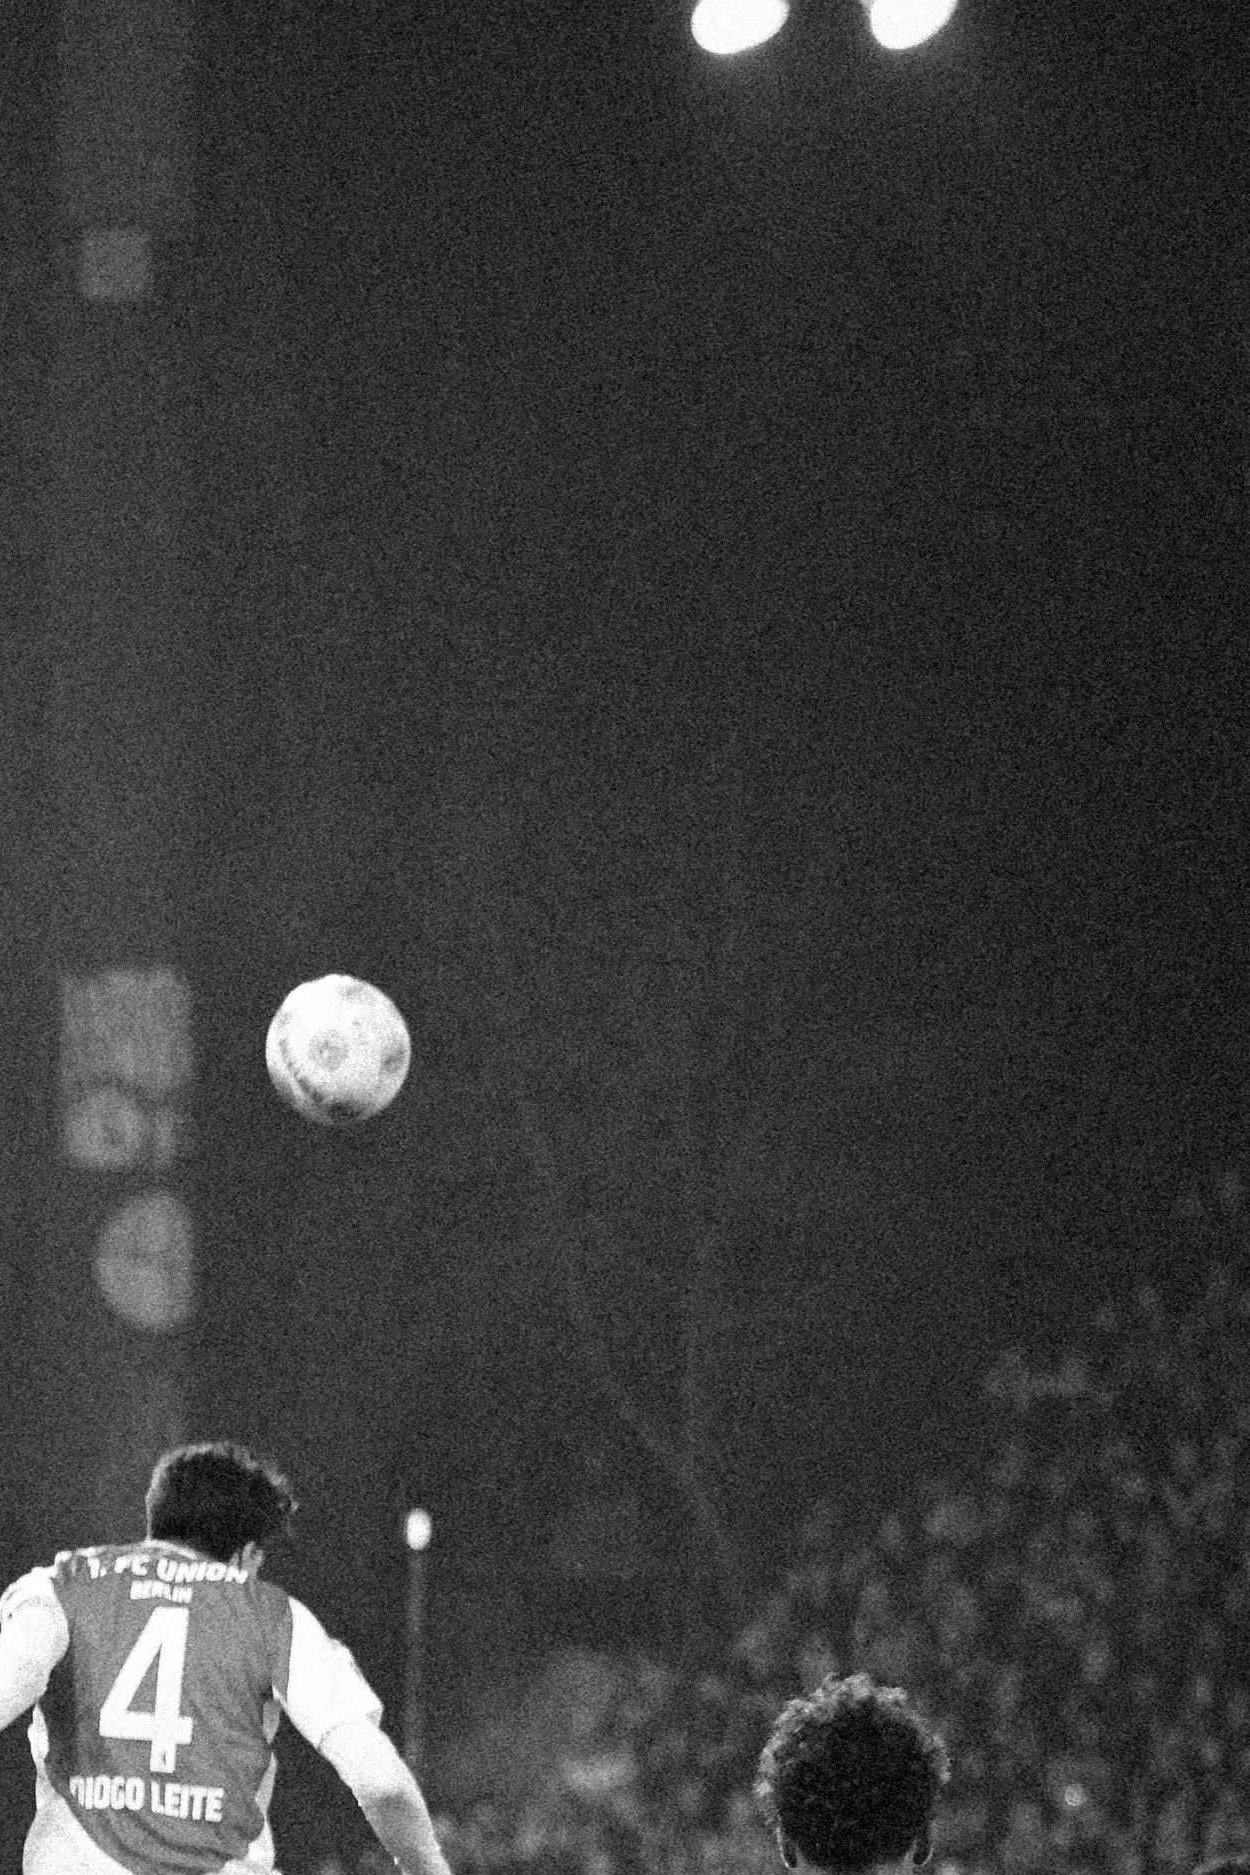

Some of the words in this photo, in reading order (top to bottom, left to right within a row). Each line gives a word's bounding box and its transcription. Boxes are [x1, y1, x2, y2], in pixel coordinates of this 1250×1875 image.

[86, 1556, 107, 1580] 1.
[157, 1557, 249, 1585] UNION
[99, 1606, 194, 1774] 4
[69, 1774, 145, 1811] DIOGO
[150, 1779, 225, 1823] LEITE
